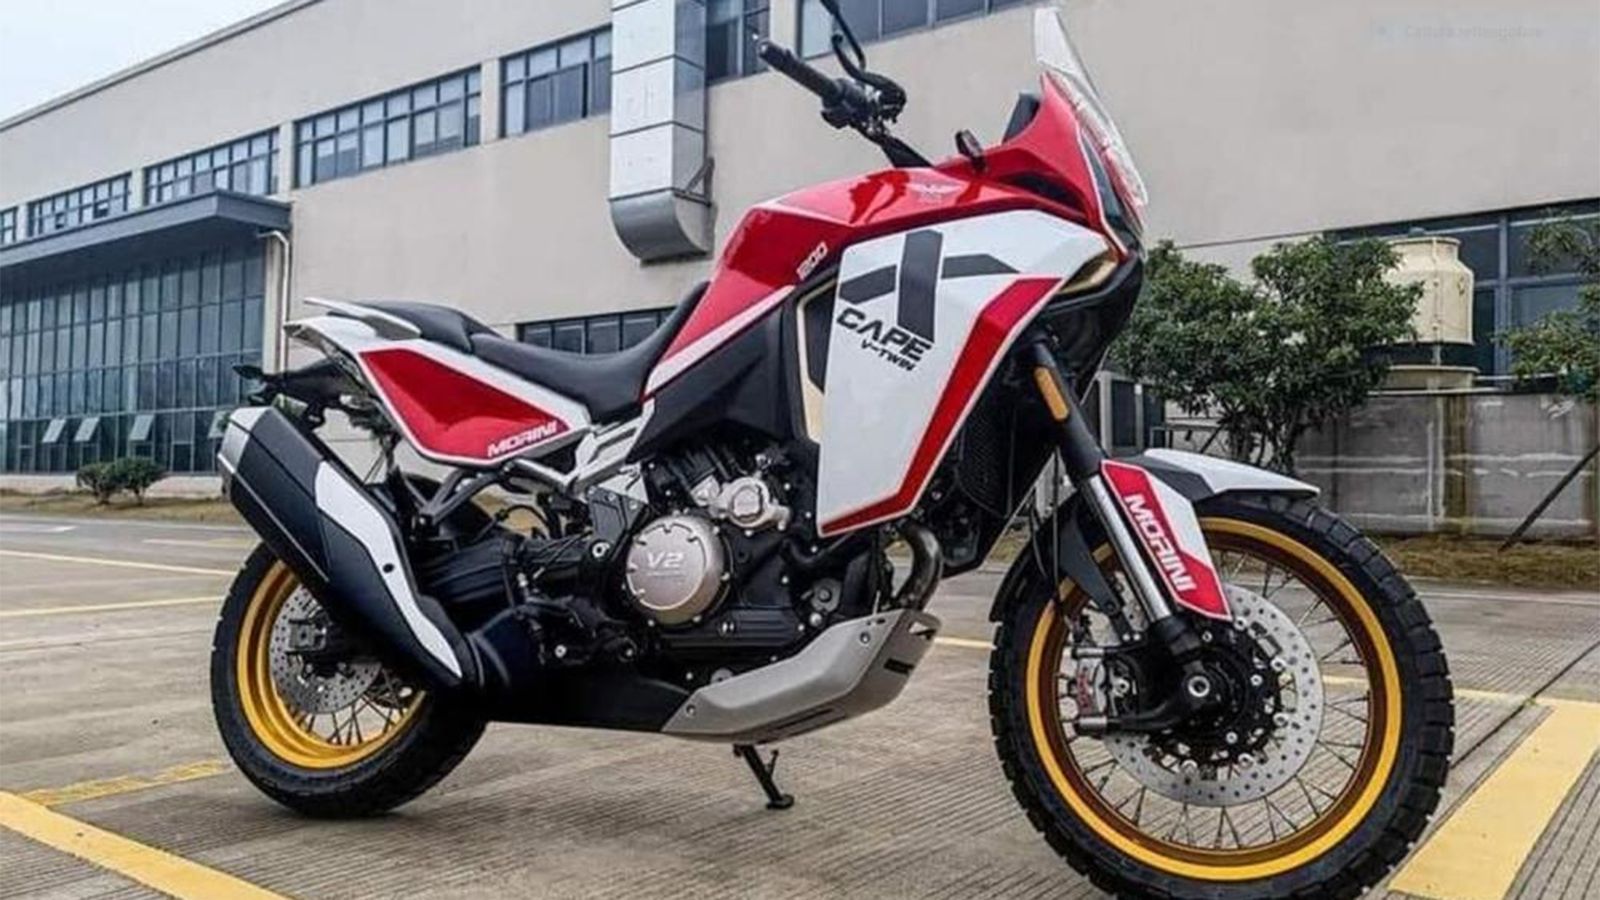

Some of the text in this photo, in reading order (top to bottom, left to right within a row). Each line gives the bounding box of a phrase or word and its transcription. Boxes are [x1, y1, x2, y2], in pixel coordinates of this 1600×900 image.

[836, 307, 932, 362] CAPE
[861, 339, 915, 371] V-TWIN
[487, 420, 558, 458] MORINI
[647, 551, 684, 568] V2
[1123, 493, 1197, 592] MORINI
